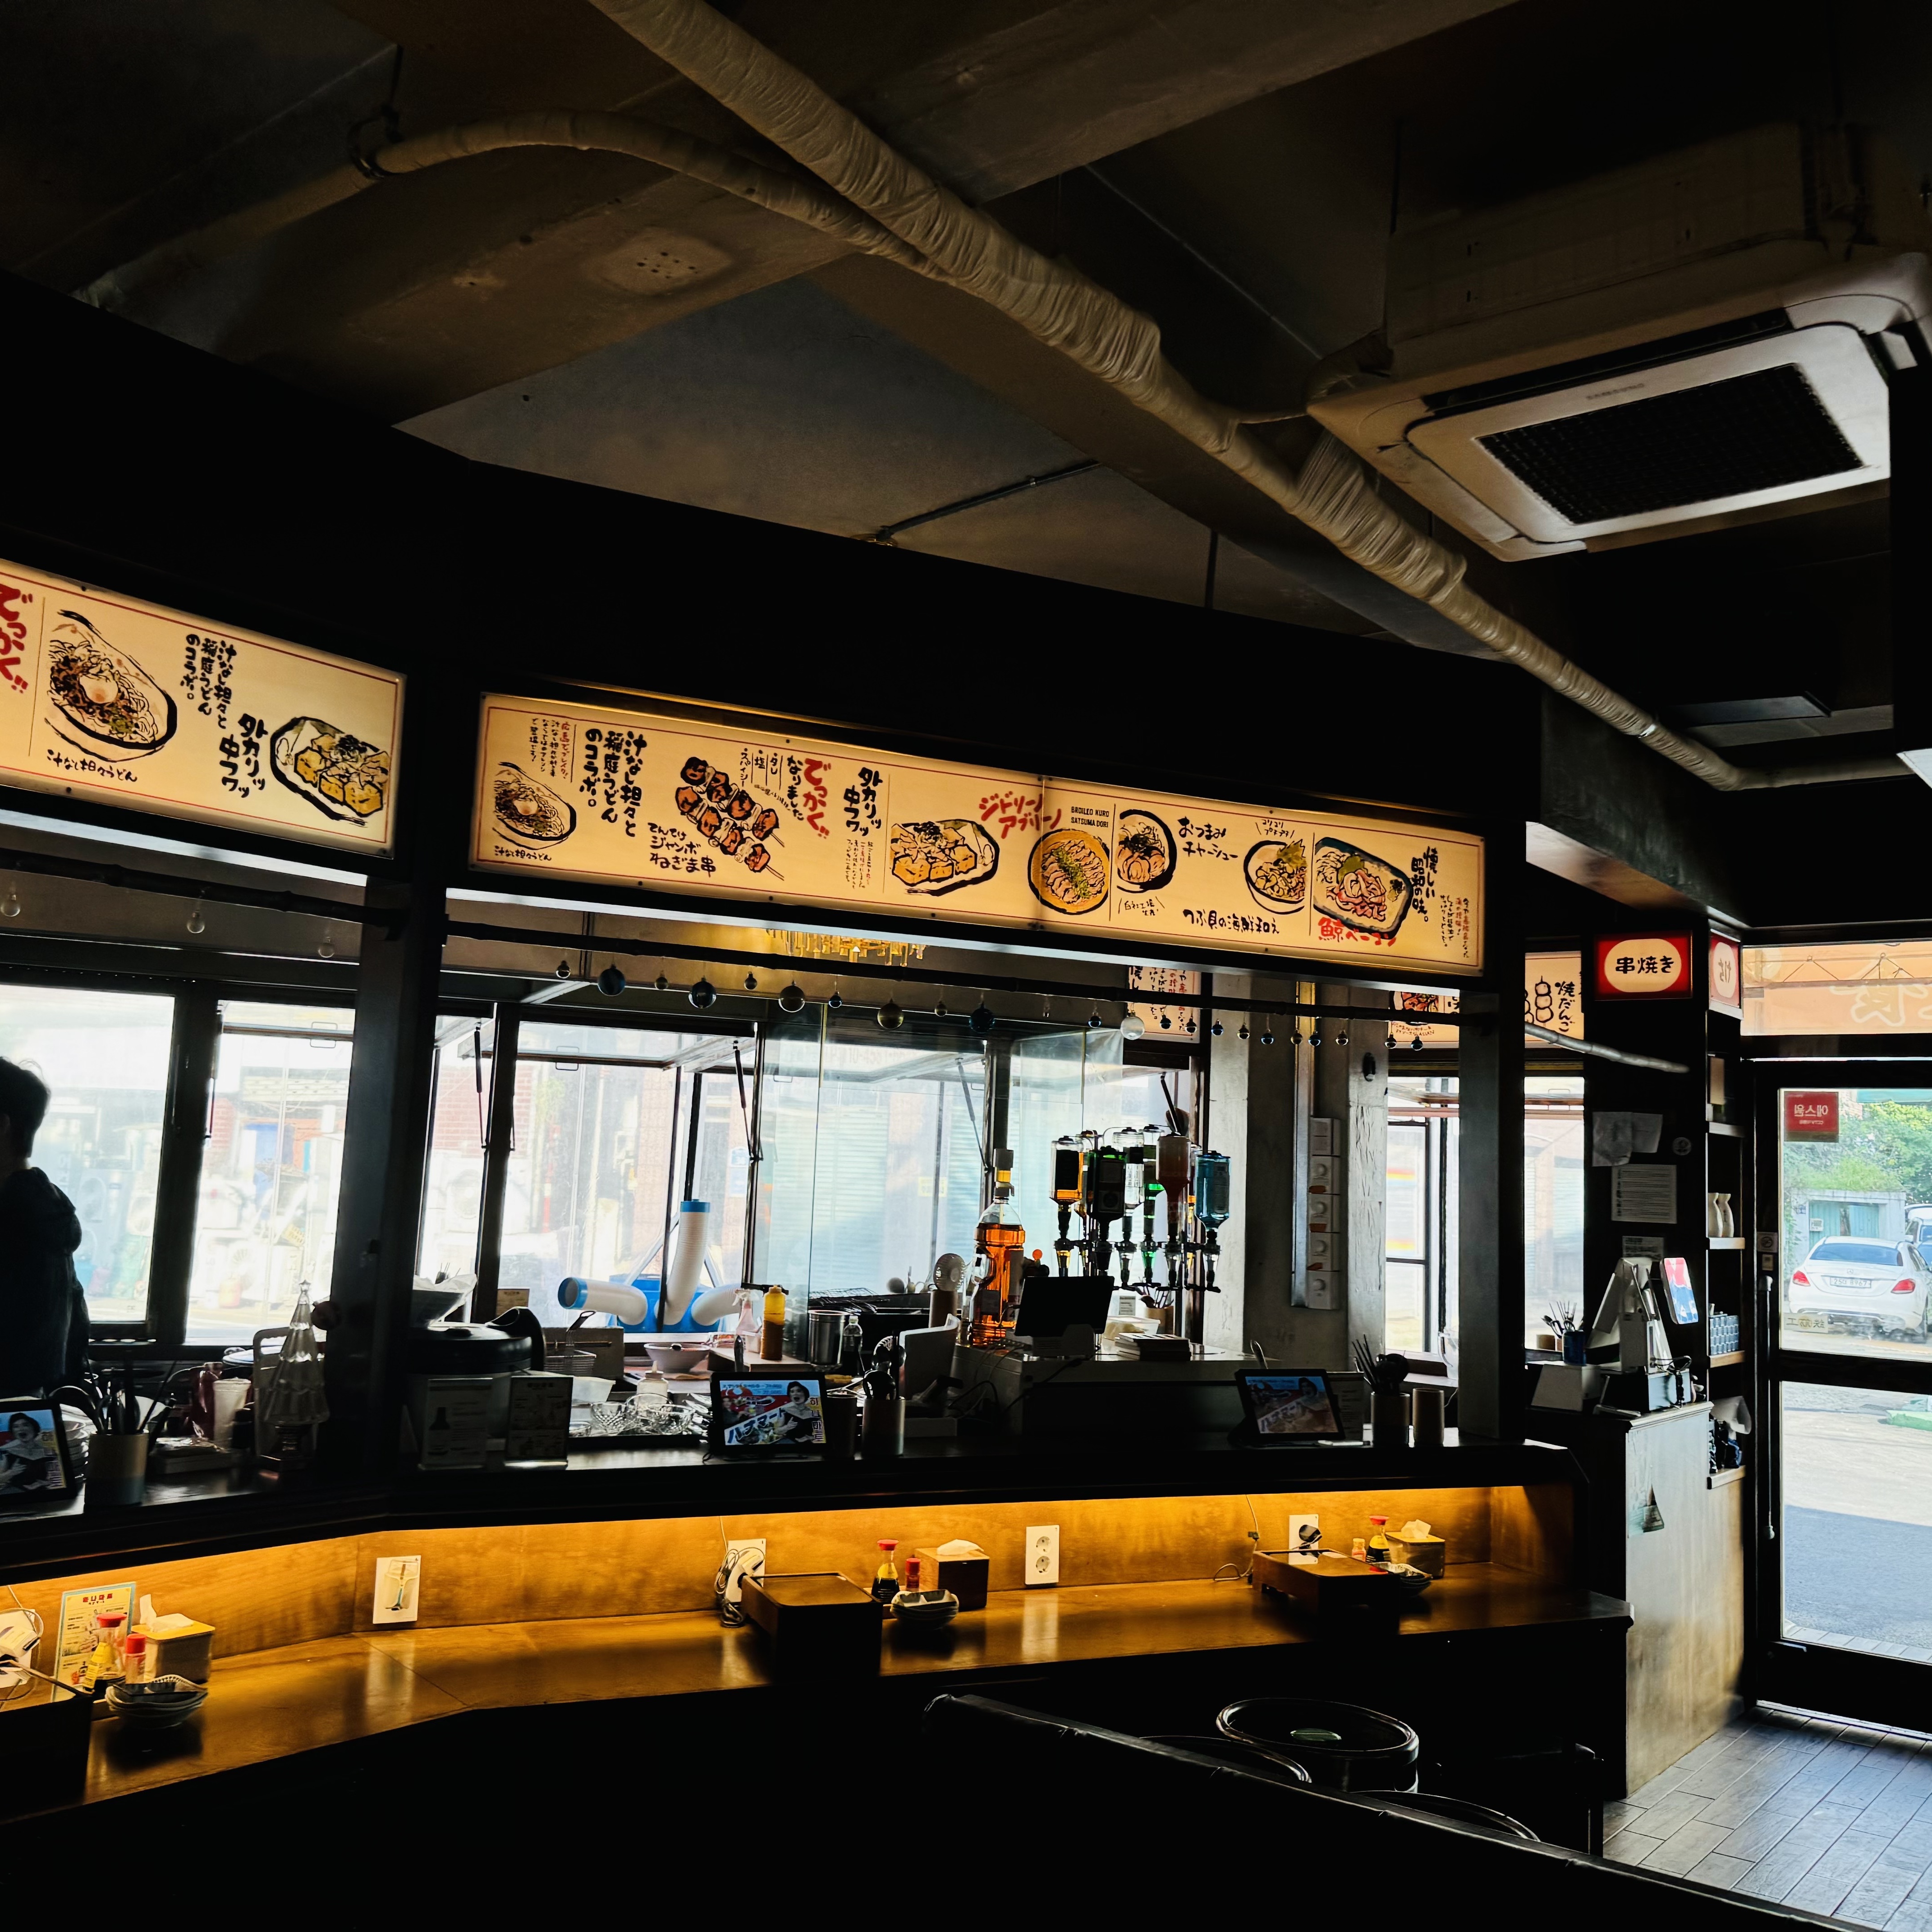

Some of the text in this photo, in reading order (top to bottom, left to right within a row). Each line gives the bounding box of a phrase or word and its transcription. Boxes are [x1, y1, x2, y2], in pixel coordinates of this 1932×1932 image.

[238, 713, 268, 791] 外カリッ
[219, 734, 249, 798] 中フワッ
[787, 755, 804, 821] なりました
[858, 767, 883, 829] 外カリッ
[843, 785, 869, 836] 中フワッ
[1071, 806, 1109, 817] BROILED KURO
[1071, 817, 1096, 826] SATSUMA
[1177, 816, 1226, 840] おつまみ
[650, 836, 701, 855] ジャンボ
[1182, 841, 1238, 860] チャーシュー
[650, 855, 716, 878] ねぎま串
[1318, 917, 1397, 947] 鯨ベーコン
[1615, 955, 1675, 974] 串焼き
[1555, 981, 1575, 1032] 焼だんご
